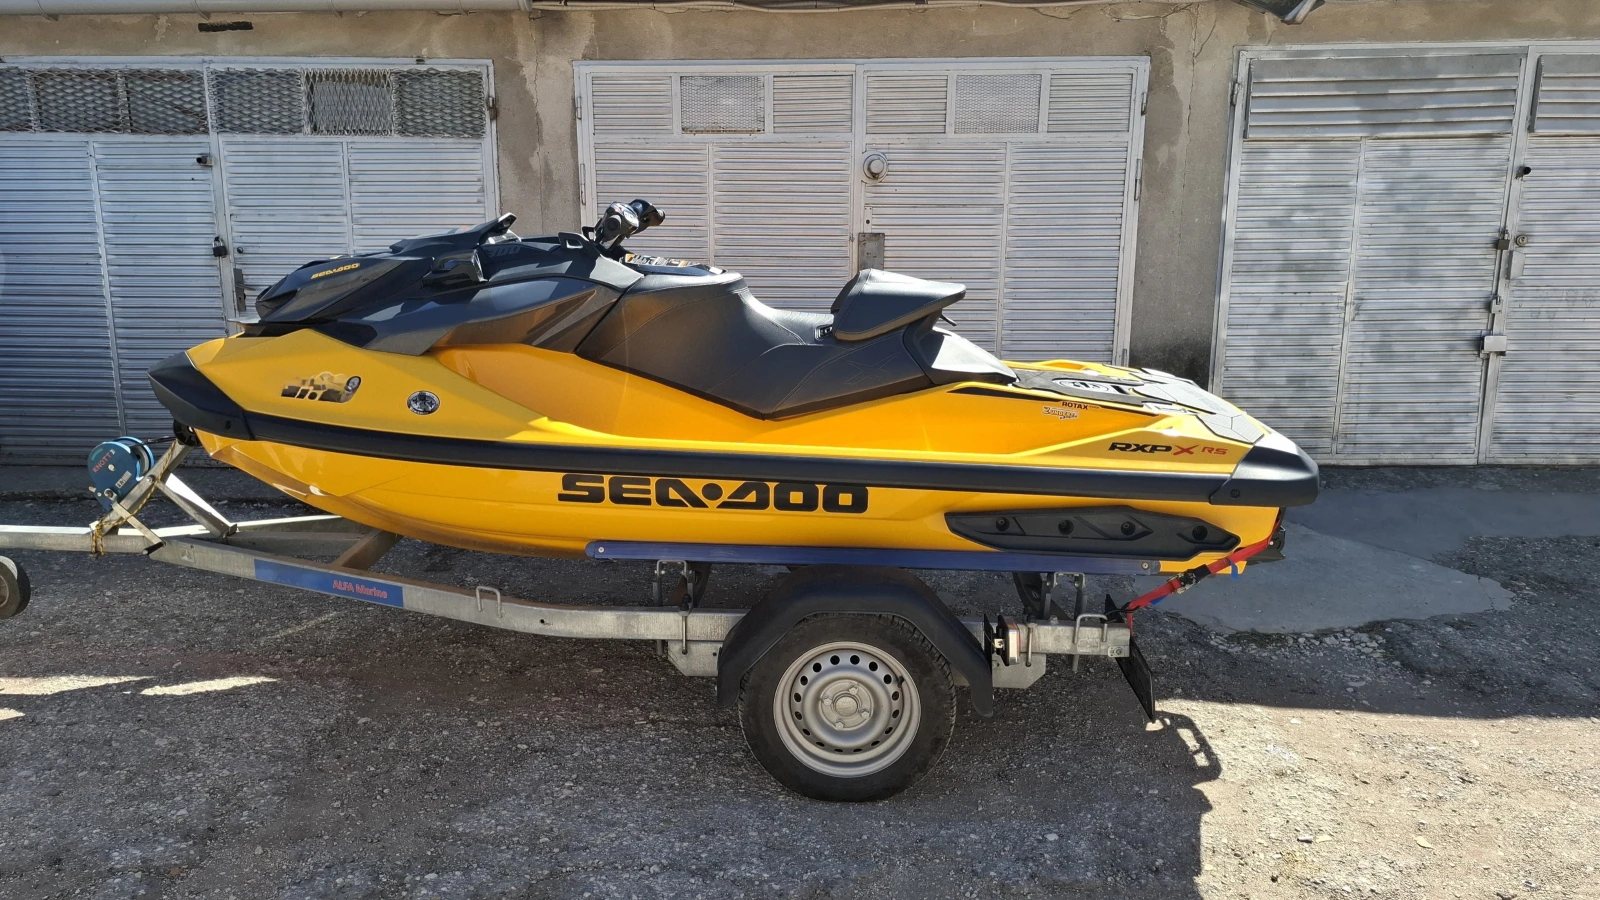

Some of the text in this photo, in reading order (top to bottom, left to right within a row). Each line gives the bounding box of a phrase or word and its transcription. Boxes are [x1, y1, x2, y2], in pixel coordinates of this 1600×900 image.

[1061, 401, 1088, 410] ROTAX
[1201, 446, 1228, 455] RS
[92, 452, 112, 473] KNOTT
[333, 580, 388, 598] ALFA Marine
